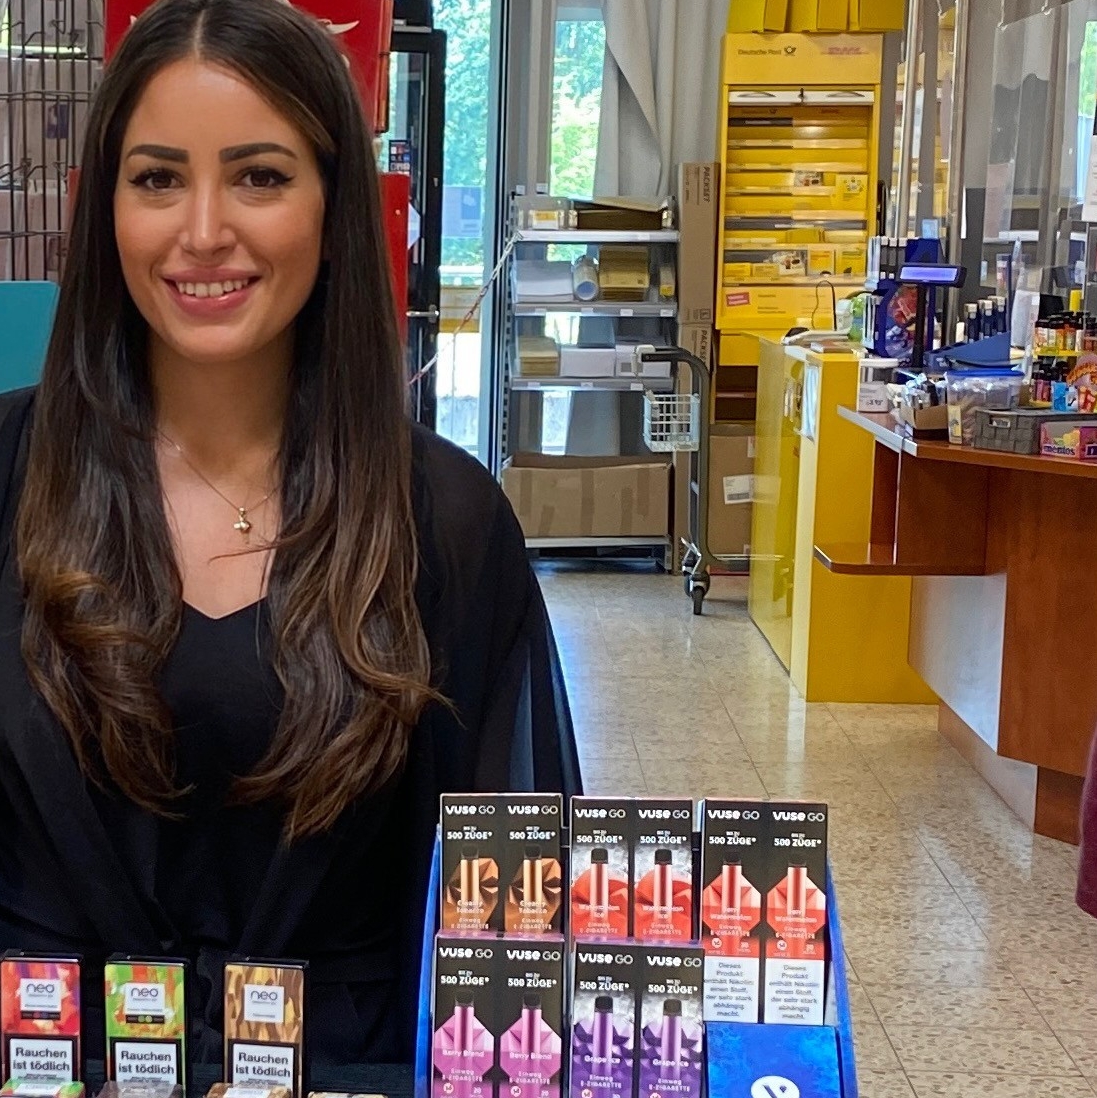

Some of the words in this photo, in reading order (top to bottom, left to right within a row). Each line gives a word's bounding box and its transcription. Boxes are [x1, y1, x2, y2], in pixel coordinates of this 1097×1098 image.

[479, 805, 495, 815] GO
[541, 805, 558, 815] GO
[609, 808, 626, 818] GO
[672, 809, 689, 819] GO
[742, 810, 760, 820] GO
[807, 812, 825, 822] GO
[447, 832, 463, 840] 500
[509, 832, 525, 840] 500
[576, 835, 593, 843] 500
[640, 836, 656, 844] 500
[709, 836, 726, 845] 500
[774, 838, 790, 847] 500
[475, 948, 493, 959] GO
[542, 951, 561, 961] GO
[615, 954, 633, 965] GO
[683, 957, 702, 968] GO
[440, 975, 457, 984] 500
[508, 978, 525, 987] 500
[26, 983, 55, 995] neo
[579, 982, 596, 990] 500
[648, 984, 666, 993] 500
[130, 987, 159, 998] neo
[250, 990, 278, 1001] neo
[15, 1047, 67, 1060] Rauchen
[121, 1051, 172, 1062] Rauchen
[238, 1052, 289, 1065] Rauchen
[12, 1061, 26, 1070] ist
[28, 1060, 70, 1072] tödlich
[118, 1064, 132, 1074] ist
[134, 1063, 175, 1075] tödlich
[235, 1065, 248, 1075] ist
[249, 1065, 291, 1077] tödlich
